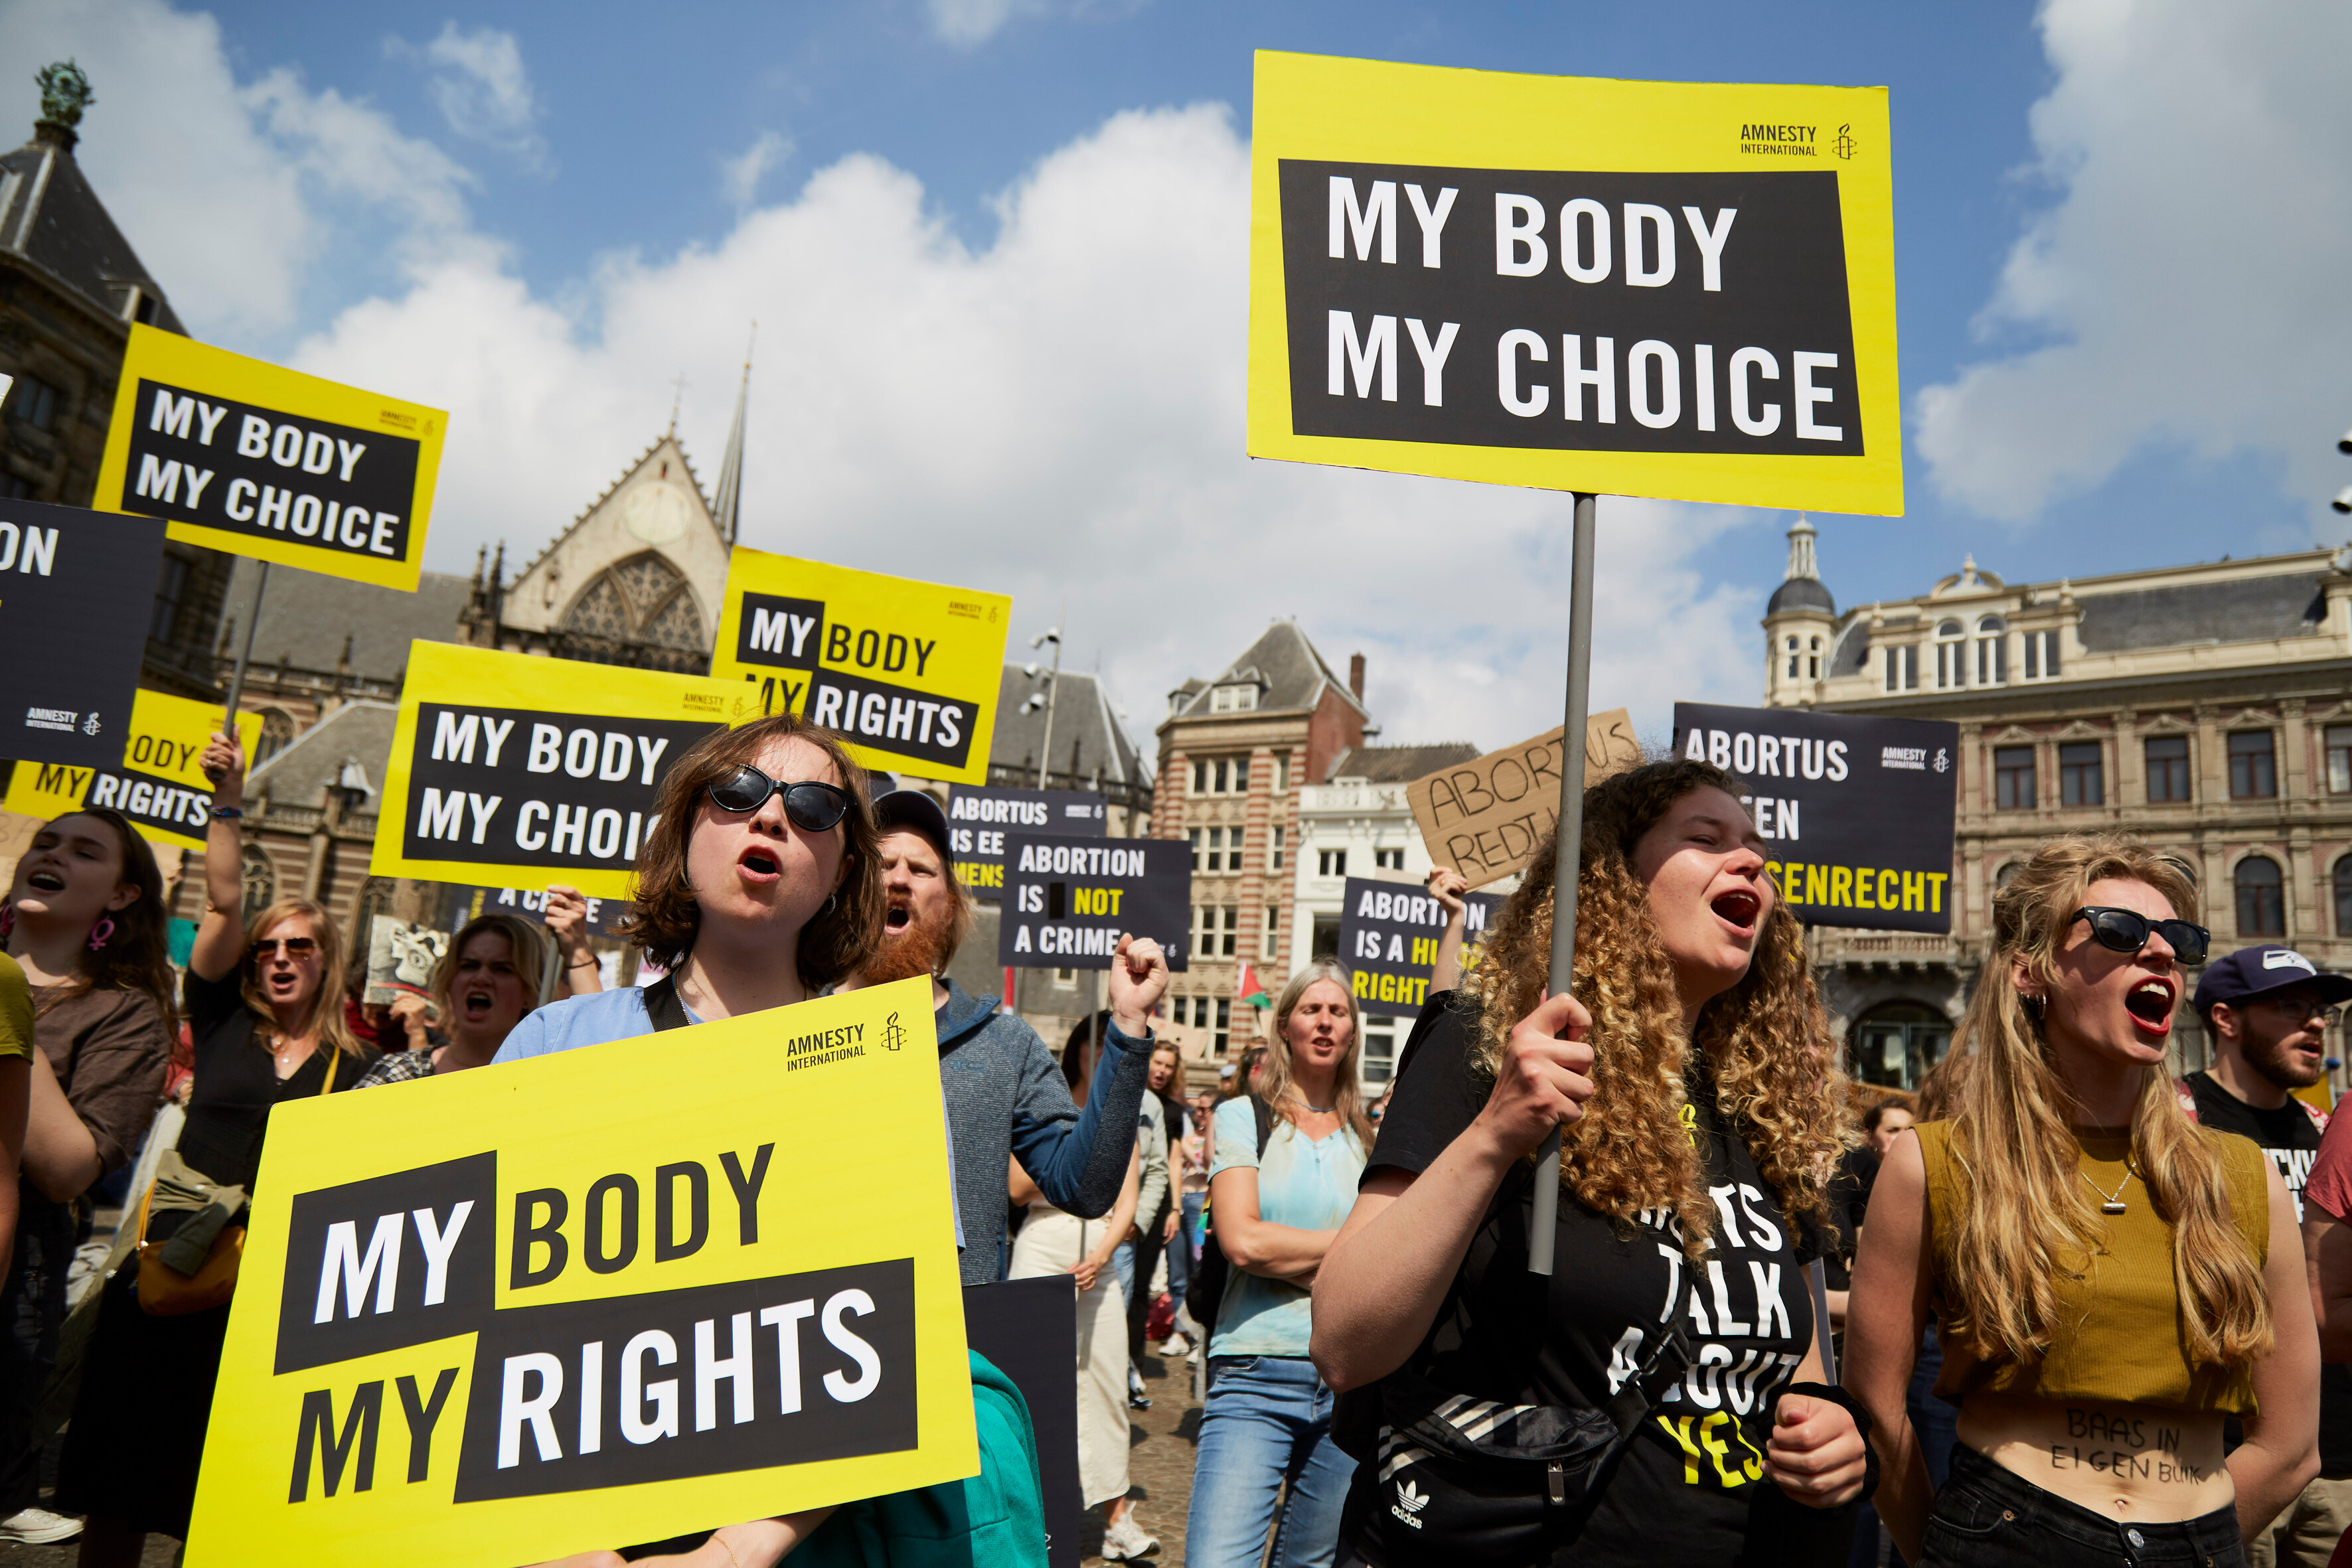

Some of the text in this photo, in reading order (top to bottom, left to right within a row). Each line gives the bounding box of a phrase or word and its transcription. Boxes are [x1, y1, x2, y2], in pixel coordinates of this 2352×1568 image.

[1741, 124, 1817, 141] AMNESTY
[1741, 144, 1818, 156] INTERNATIONAL
[1328, 176, 1738, 292] MY BODY
[1328, 309, 1843, 441] MY CHOICE
[151, 389, 366, 482] MY BODY
[135, 453, 400, 555] MY CHOICE
[749, 607, 935, 676] MY BODY
[27, 707, 78, 724] AMNESTY
[683, 692, 725, 705] AMNESTY
[814, 684, 963, 748] RIGHTS
[26, 719, 75, 732] INTERNATIONAL
[133, 735, 196, 771] ODY
[431, 711, 669, 785] MY BODY
[1686, 728, 1848, 782] ABORTUS
[1881, 759, 1926, 770] INTERNATIONAL
[1883, 747, 1926, 762] AMNESTY
[35, 763, 212, 827] MY RIGHTS
[951, 796, 1048, 826] ABORTUS
[417, 787, 661, 861] MY CHOI
[1739, 795, 1800, 841] EN
[951, 828, 1005, 855] IS EE
[1018, 844, 1145, 878] ABORTION
[497, 888, 516, 907] A
[1018, 884, 1124, 916] IS NOT
[1014, 925, 1121, 956] A CRIME
[1355, 929, 1382, 960] IS
[1386, 933, 1404, 963] A
[1351, 969, 1430, 1006] RIGHT
[787, 1023, 864, 1058] AMNESTY
[787, 1045, 866, 1072] INTERNATIONAL
[314, 1142, 775, 1325] MY BODY
[288, 1288, 882, 1504] MY RIGHTS
[1656, 1410, 1763, 1488] YES
[2067, 1408, 2180, 1454] BAAS IN
[2051, 1445, 2200, 1486] EIGEN BUIK
[1391, 1504, 1423, 1529] adidas
